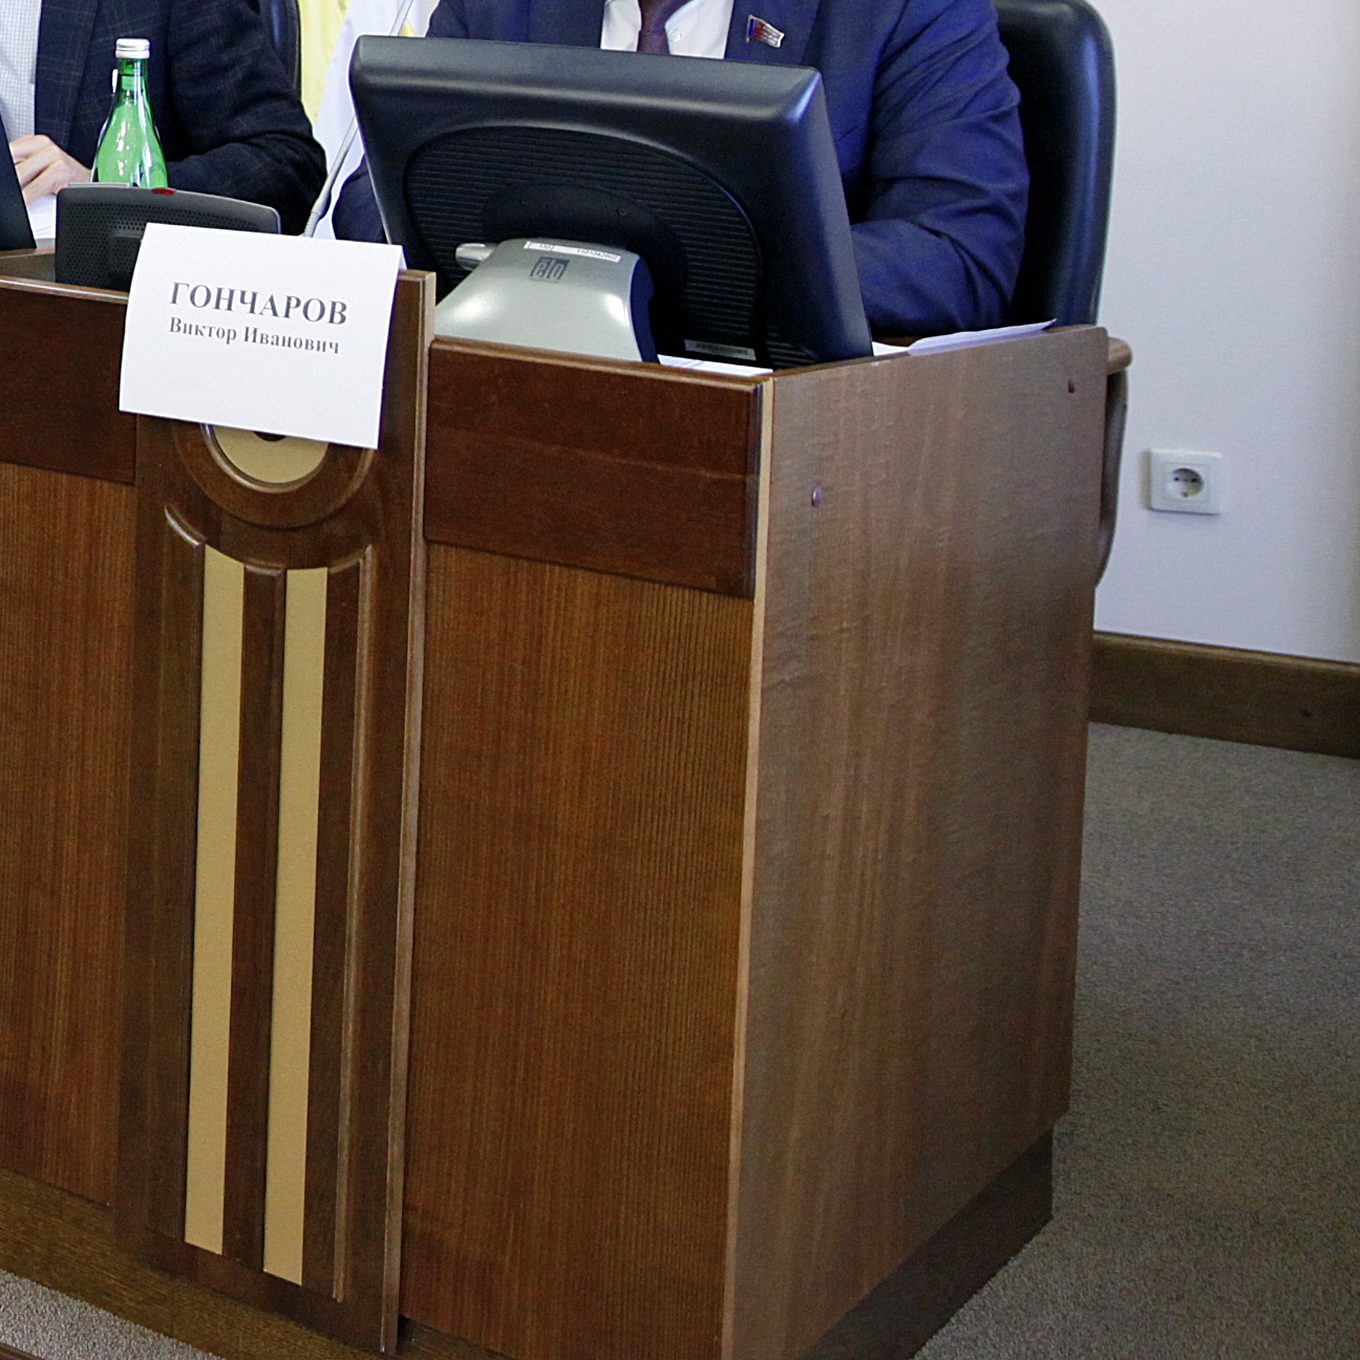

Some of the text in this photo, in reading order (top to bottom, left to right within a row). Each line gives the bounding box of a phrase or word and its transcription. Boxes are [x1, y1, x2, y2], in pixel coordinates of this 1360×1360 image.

[168, 281, 348, 326] ГОНЧАРОВ
[168, 316, 340, 355] Виктор Иванович
